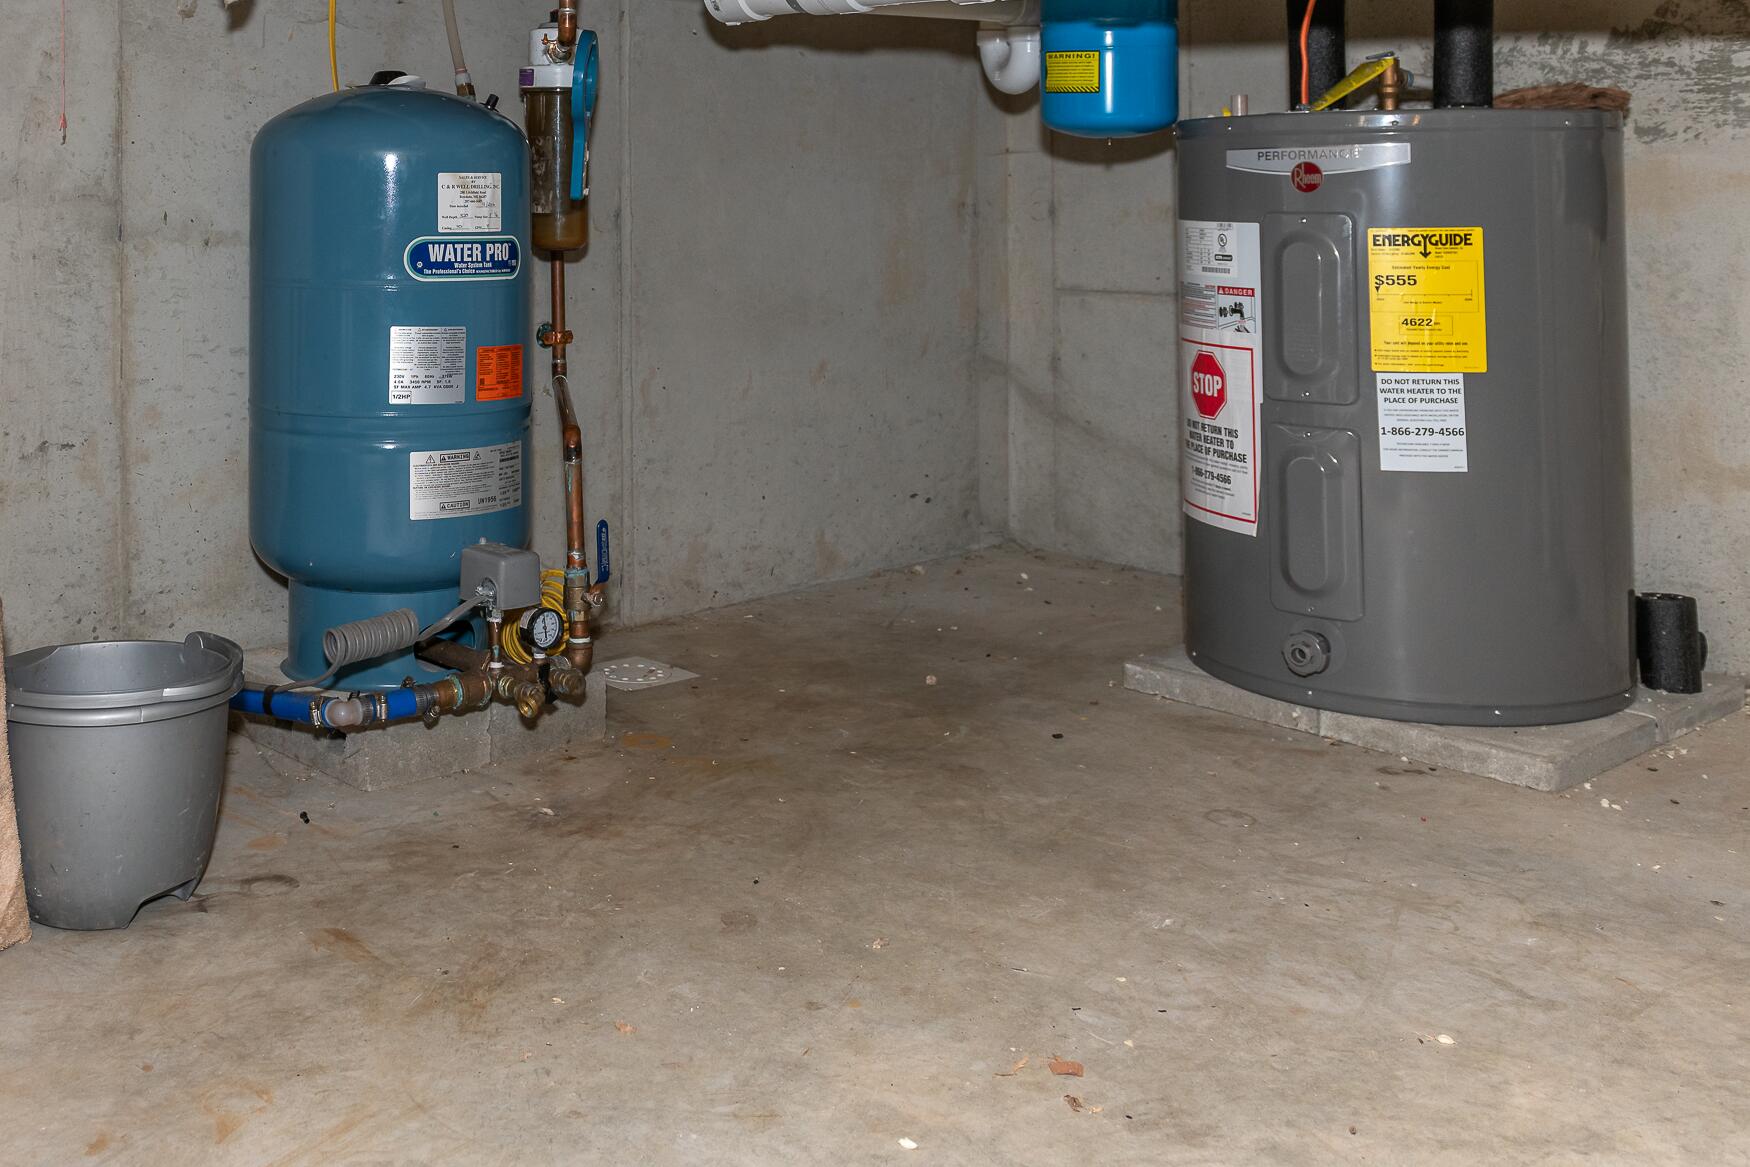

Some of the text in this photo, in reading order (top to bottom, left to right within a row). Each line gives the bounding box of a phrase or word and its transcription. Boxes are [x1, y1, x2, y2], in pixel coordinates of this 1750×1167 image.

[1294, 163, 1321, 188] Rheem
[1373, 233, 1472, 248] ENERGYGUIDE
[428, 243, 509, 262] WATER PRO
[1375, 275, 1417, 286] $555
[1402, 318, 1432, 326] 4622
[1193, 372, 1223, 397] STOP
[1201, 423, 1222, 435] RETURN
[1224, 428, 1238, 439] THIS
[1381, 427, 1464, 436] 1-866-279-4566
[1204, 435, 1224, 447] HEATER
[1226, 440, 1234, 449] TO
[1191, 442, 1204, 454] PLACE
[1205, 445, 1211, 455] OF
[1213, 448, 1247, 463] PURCHASE
